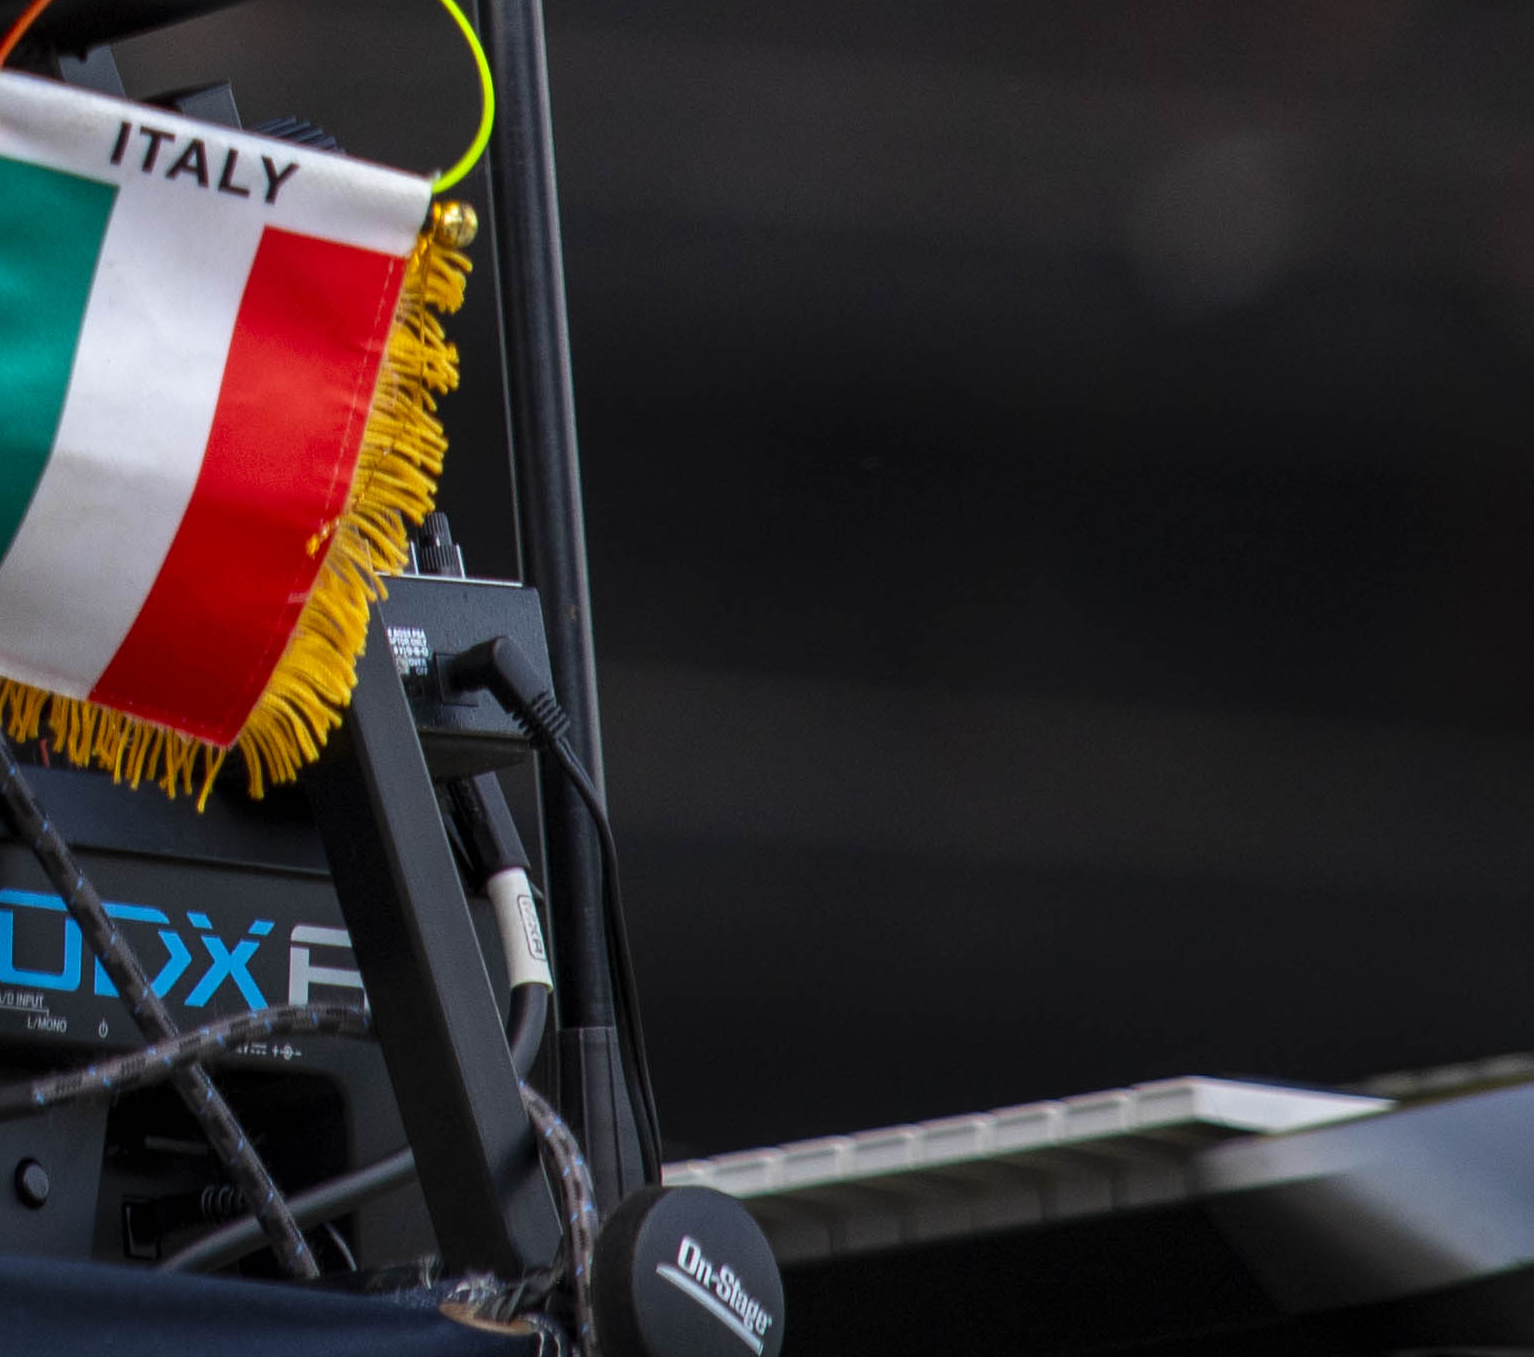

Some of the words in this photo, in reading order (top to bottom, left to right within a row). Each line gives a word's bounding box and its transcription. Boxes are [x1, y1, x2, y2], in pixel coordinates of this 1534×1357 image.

[109, 121, 300, 206] ITALY
[16, 991, 45, 1009] INPUT
[27, 1015, 68, 1034] L/MONO
[676, 1235, 772, 1336] On-Stage
